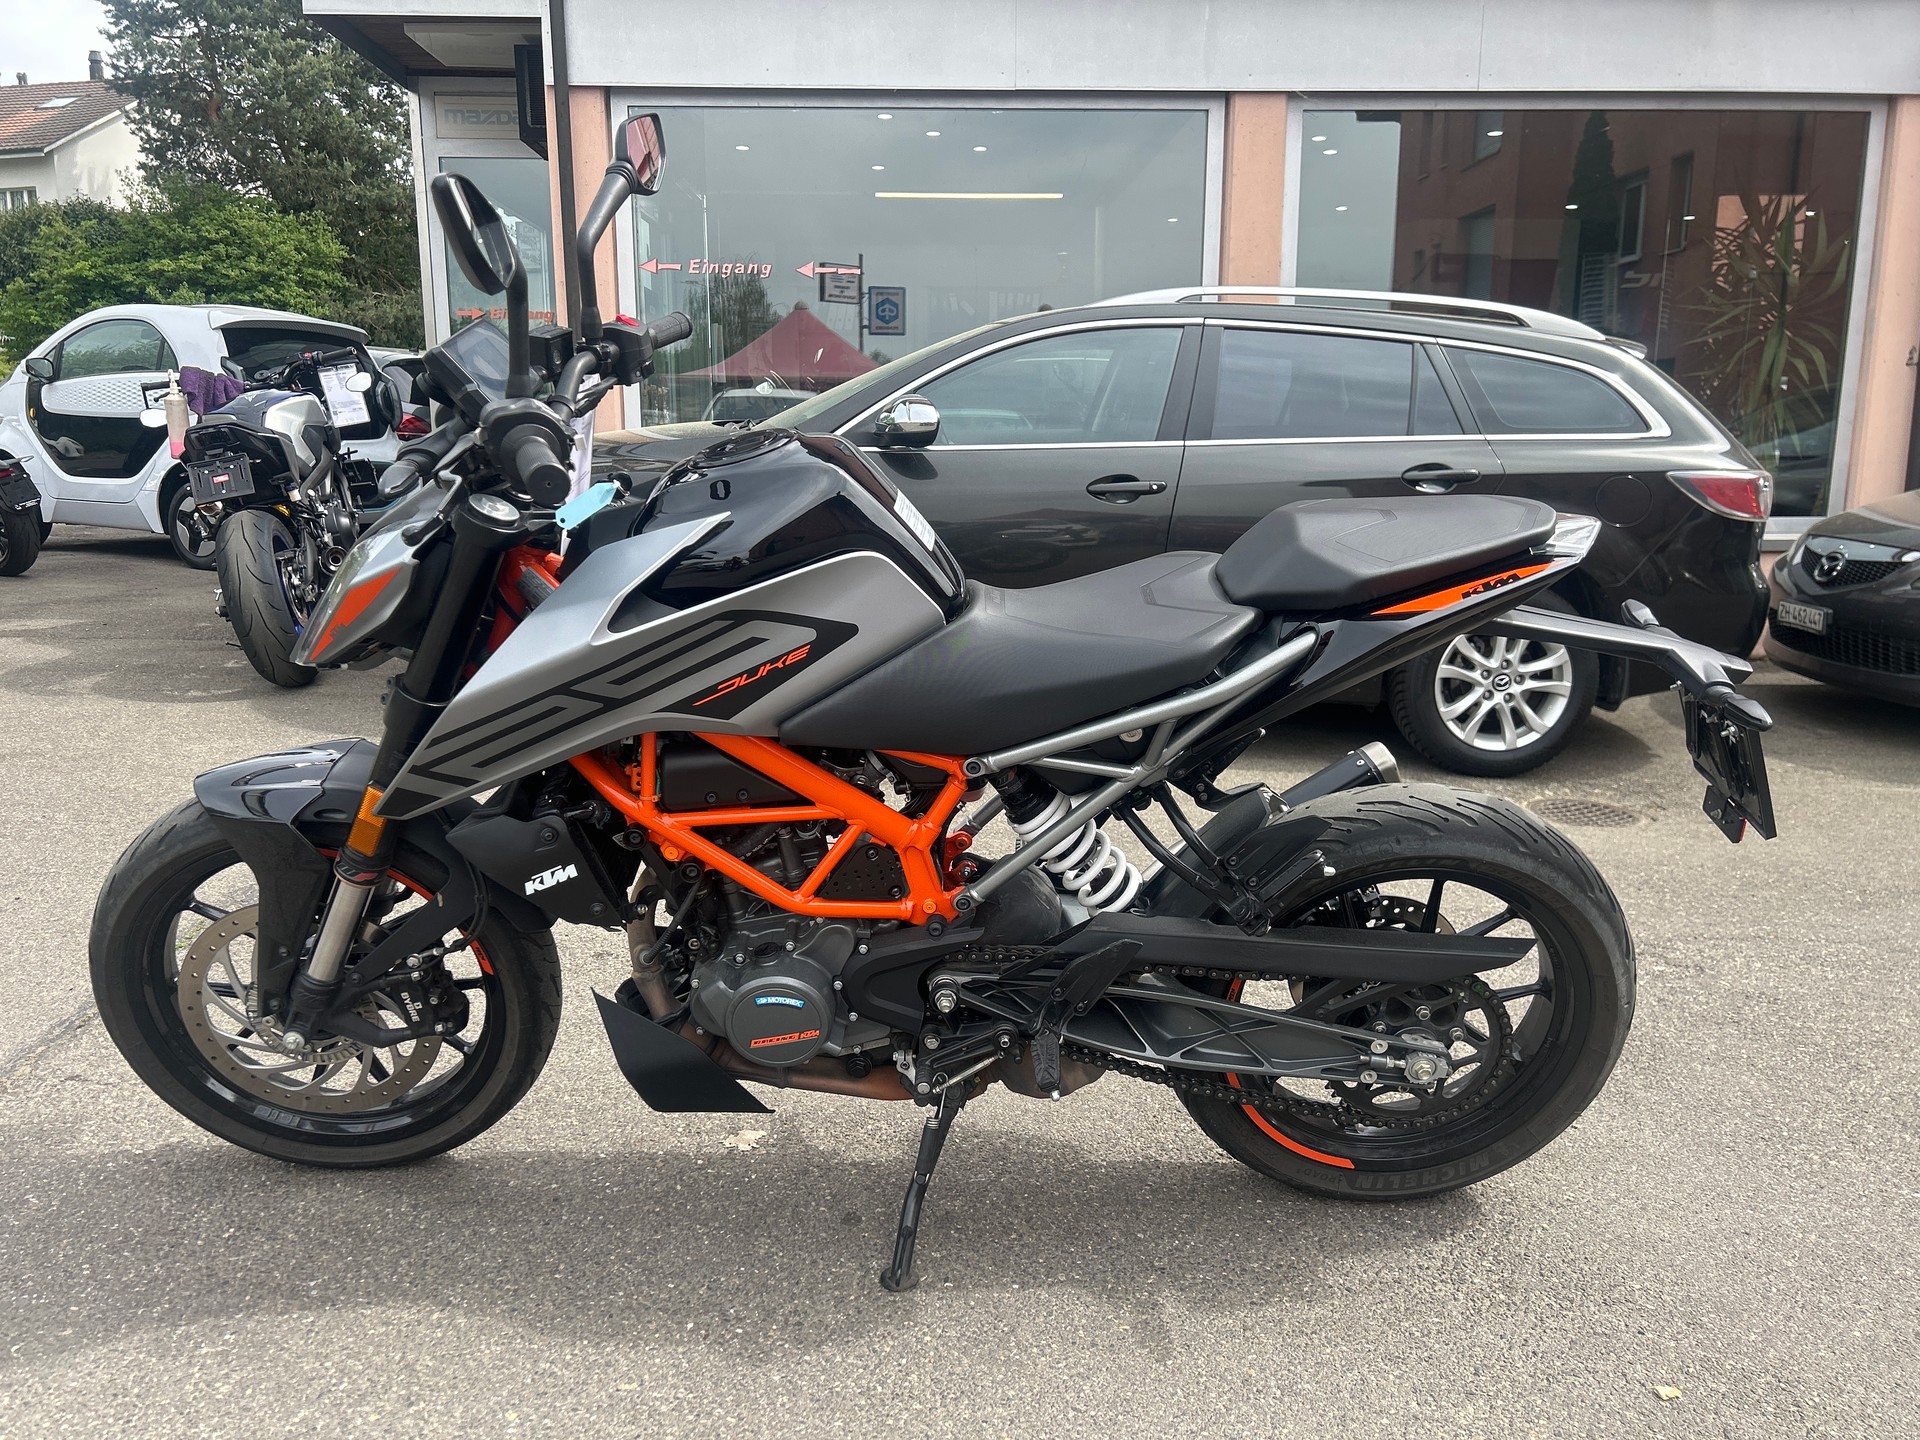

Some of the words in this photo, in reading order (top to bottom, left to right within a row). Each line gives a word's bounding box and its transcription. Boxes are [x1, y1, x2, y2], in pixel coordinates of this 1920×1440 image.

[688, 258, 773, 279] Eingang
[490, 307, 555, 325] Eiang
[692, 644, 812, 707] DUKE
[524, 863, 579, 896] KTM
[400, 991, 421, 1023] BYBRE
[767, 996, 802, 1008] MOTOREX
[1354, 1151, 1492, 1190] MICHELIN
